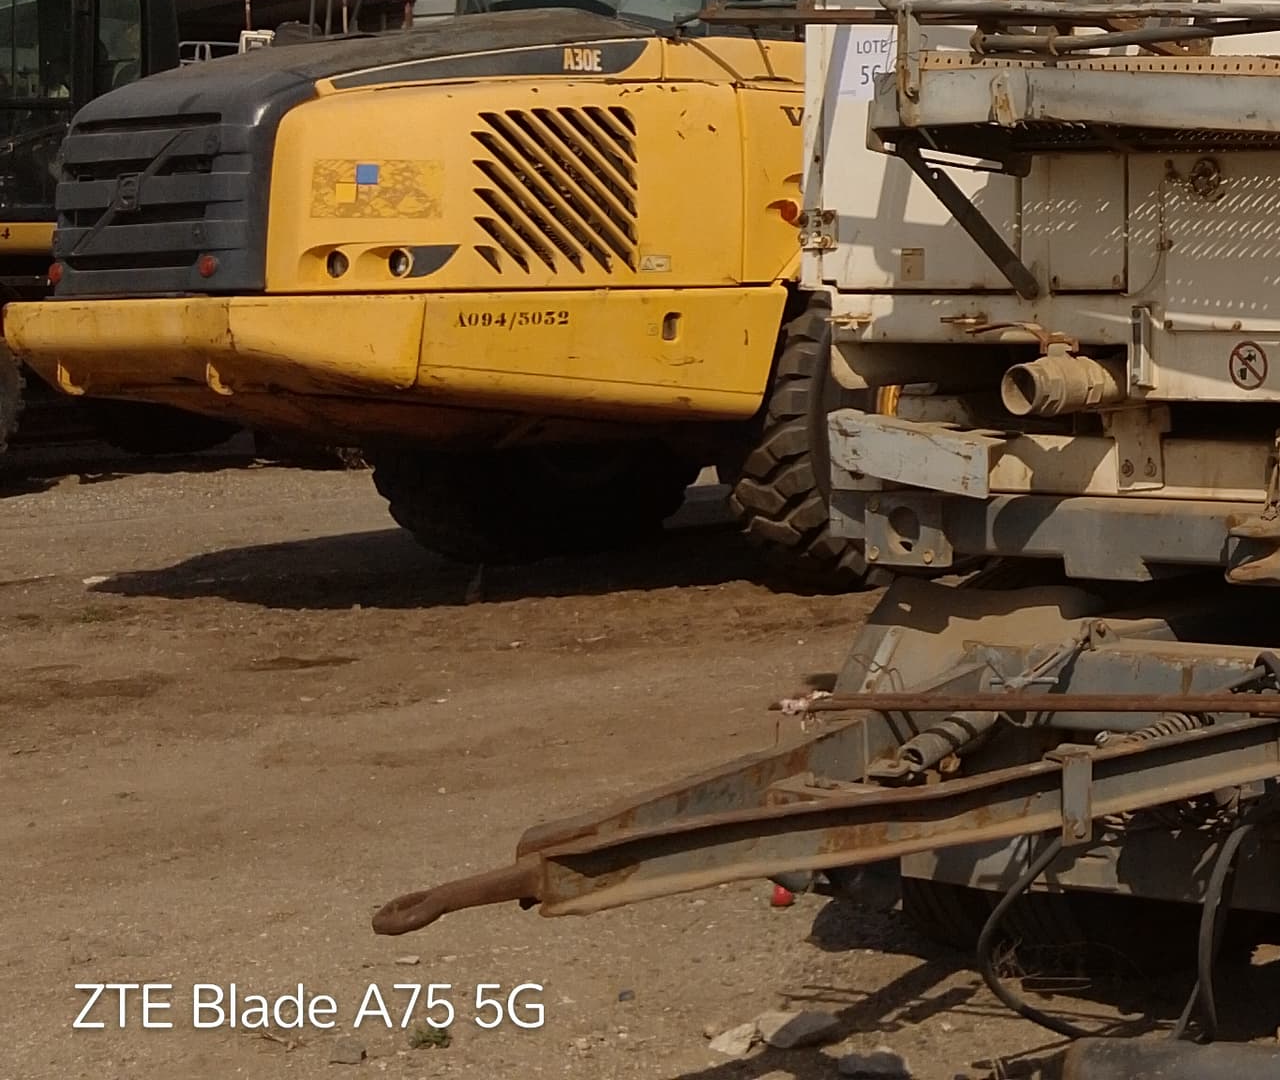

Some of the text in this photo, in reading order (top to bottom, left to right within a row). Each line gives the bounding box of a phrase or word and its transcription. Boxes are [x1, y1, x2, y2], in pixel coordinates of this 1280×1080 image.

[856, 39, 888, 54] LOTE
[563, 47, 603, 72] A30E
[455, 311, 570, 331] A094/5052
